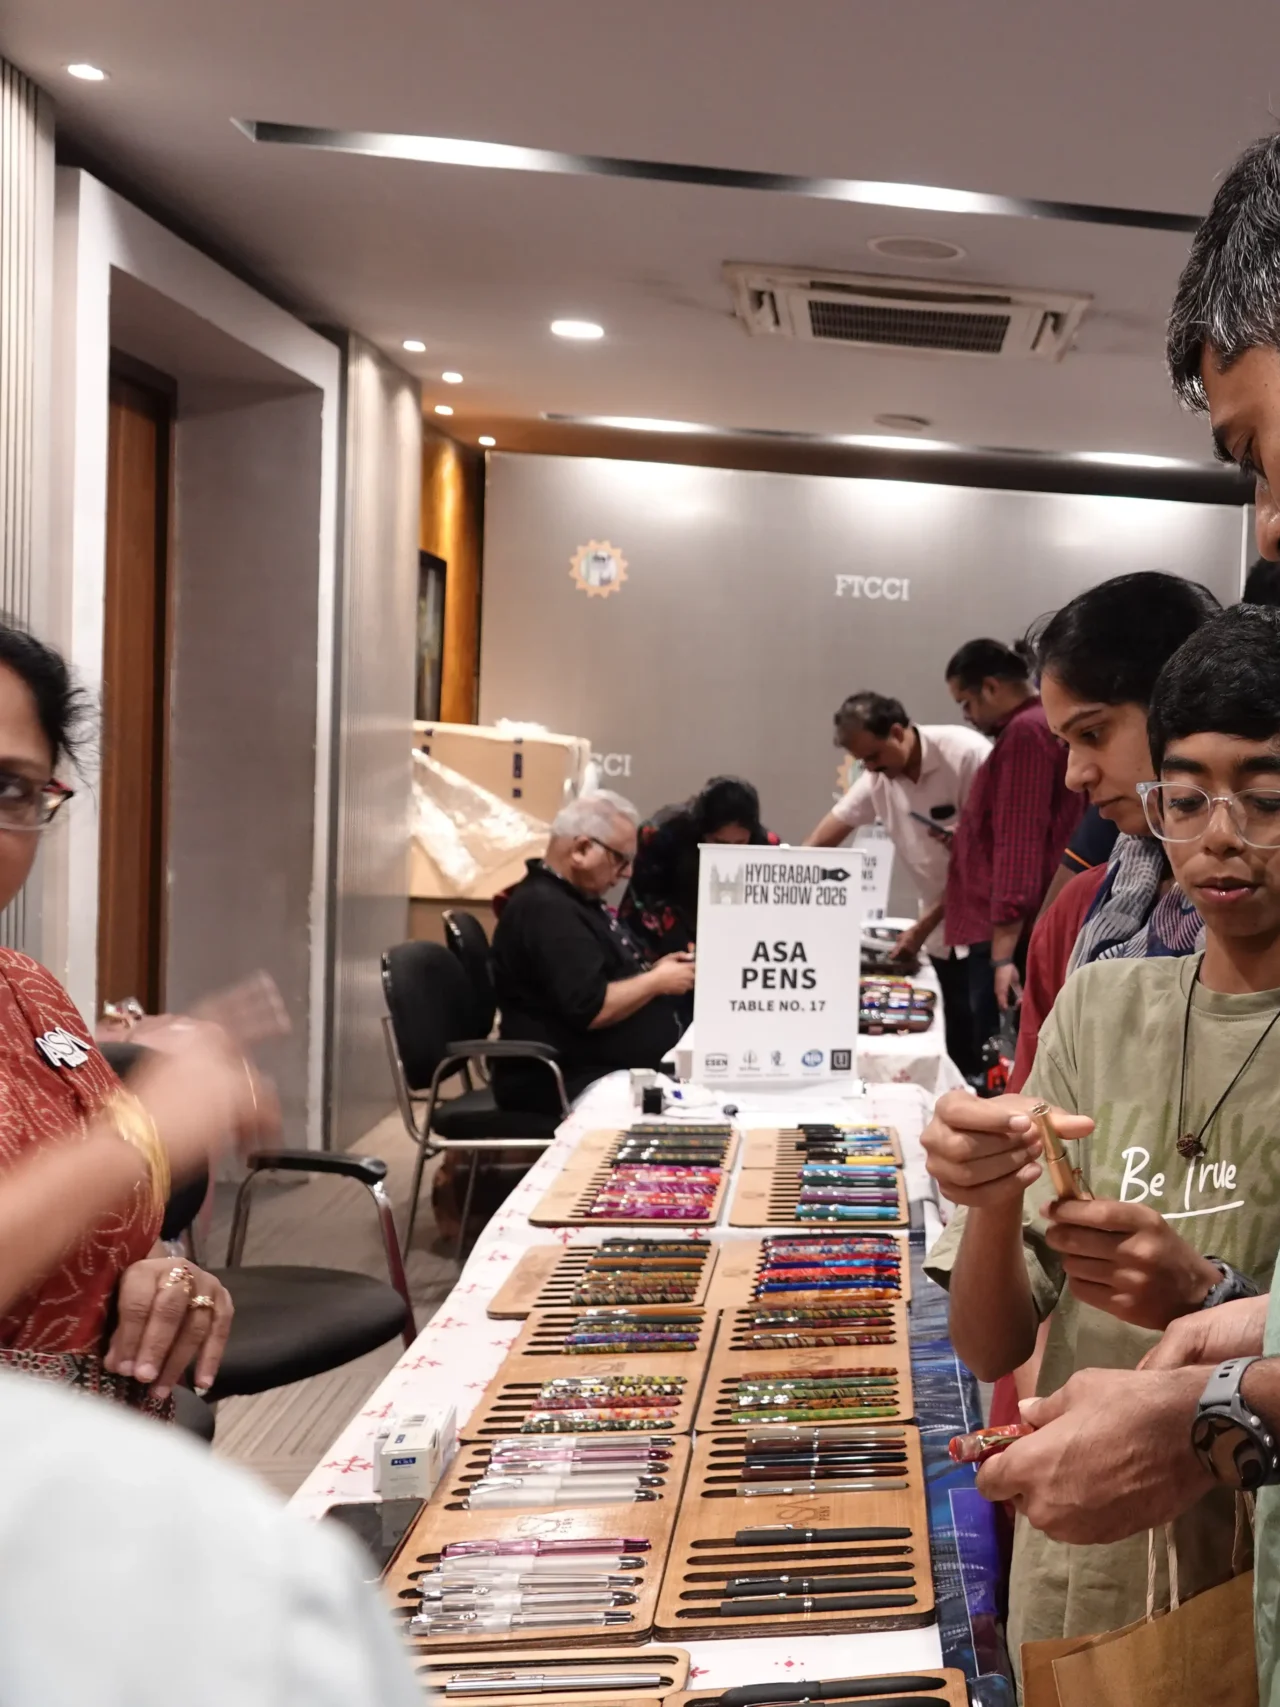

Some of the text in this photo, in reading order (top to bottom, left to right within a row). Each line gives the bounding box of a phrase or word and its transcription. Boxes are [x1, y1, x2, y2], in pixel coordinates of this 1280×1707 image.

[834, 573, 910, 602] FTCCI
[745, 863, 820, 885] HYDERABAD
[744, 884, 847, 906] PEN SHOW 2026
[751, 940, 808, 963] ASA
[741, 967, 817, 990] PENS
[729, 1000, 826, 1012] TABLE NO. 17
[1119, 1146, 1237, 1211] Be True
